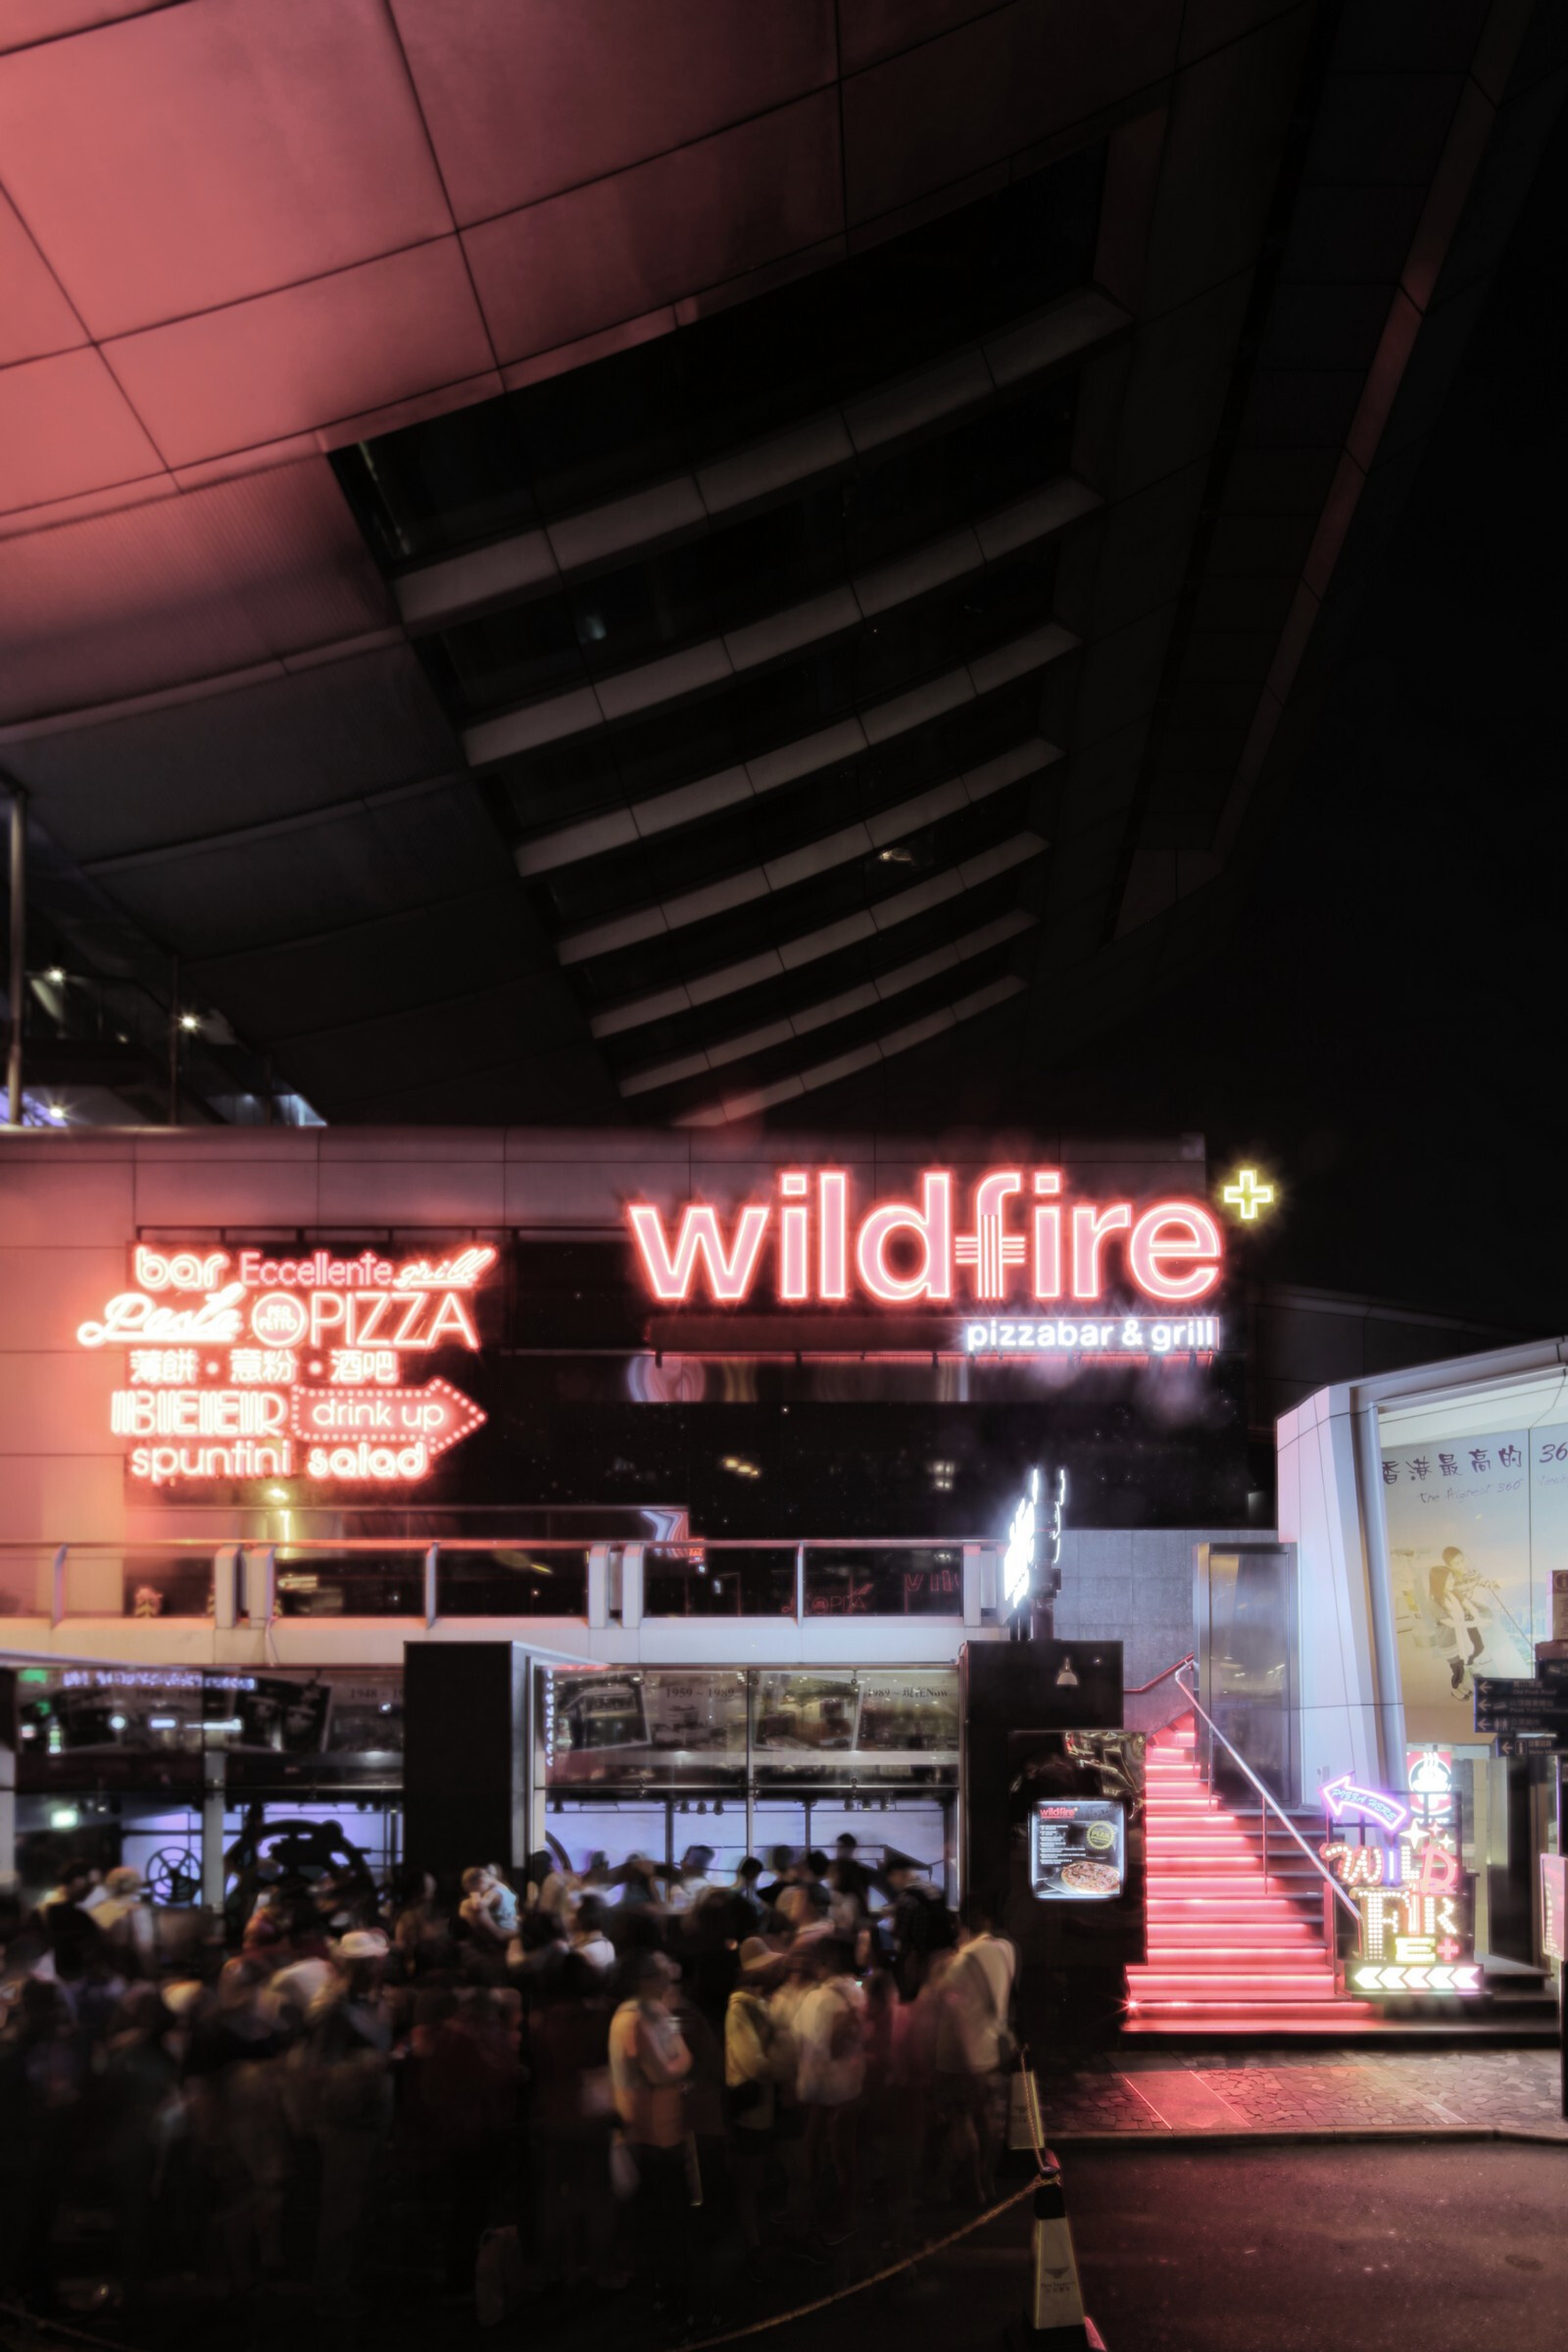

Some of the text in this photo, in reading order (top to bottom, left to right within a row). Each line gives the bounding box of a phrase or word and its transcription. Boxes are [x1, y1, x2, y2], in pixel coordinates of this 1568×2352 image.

[135, 1245, 496, 1289] bar Eccellente grill
[77, 1282, 246, 1346] Pasta
[259, 1317, 298, 1331] FETTO
[268, 1305, 291, 1317] PER
[310, 1292, 479, 1348] PIZZA
[967, 1320, 1213, 1351] pizzabar & grill
[330, 1349, 398, 1384] 酒吧
[112, 1390, 287, 1438] BEER
[313, 1398, 444, 1432] drink up
[131, 1440, 428, 1482] spuntini salad
[1382, 1445, 1523, 1486] 香港最高的
[665, 1687, 693, 1698] 1959
[1368, 1798, 1396, 1820] HERE
[1319, 1842, 1458, 1895] WILD
